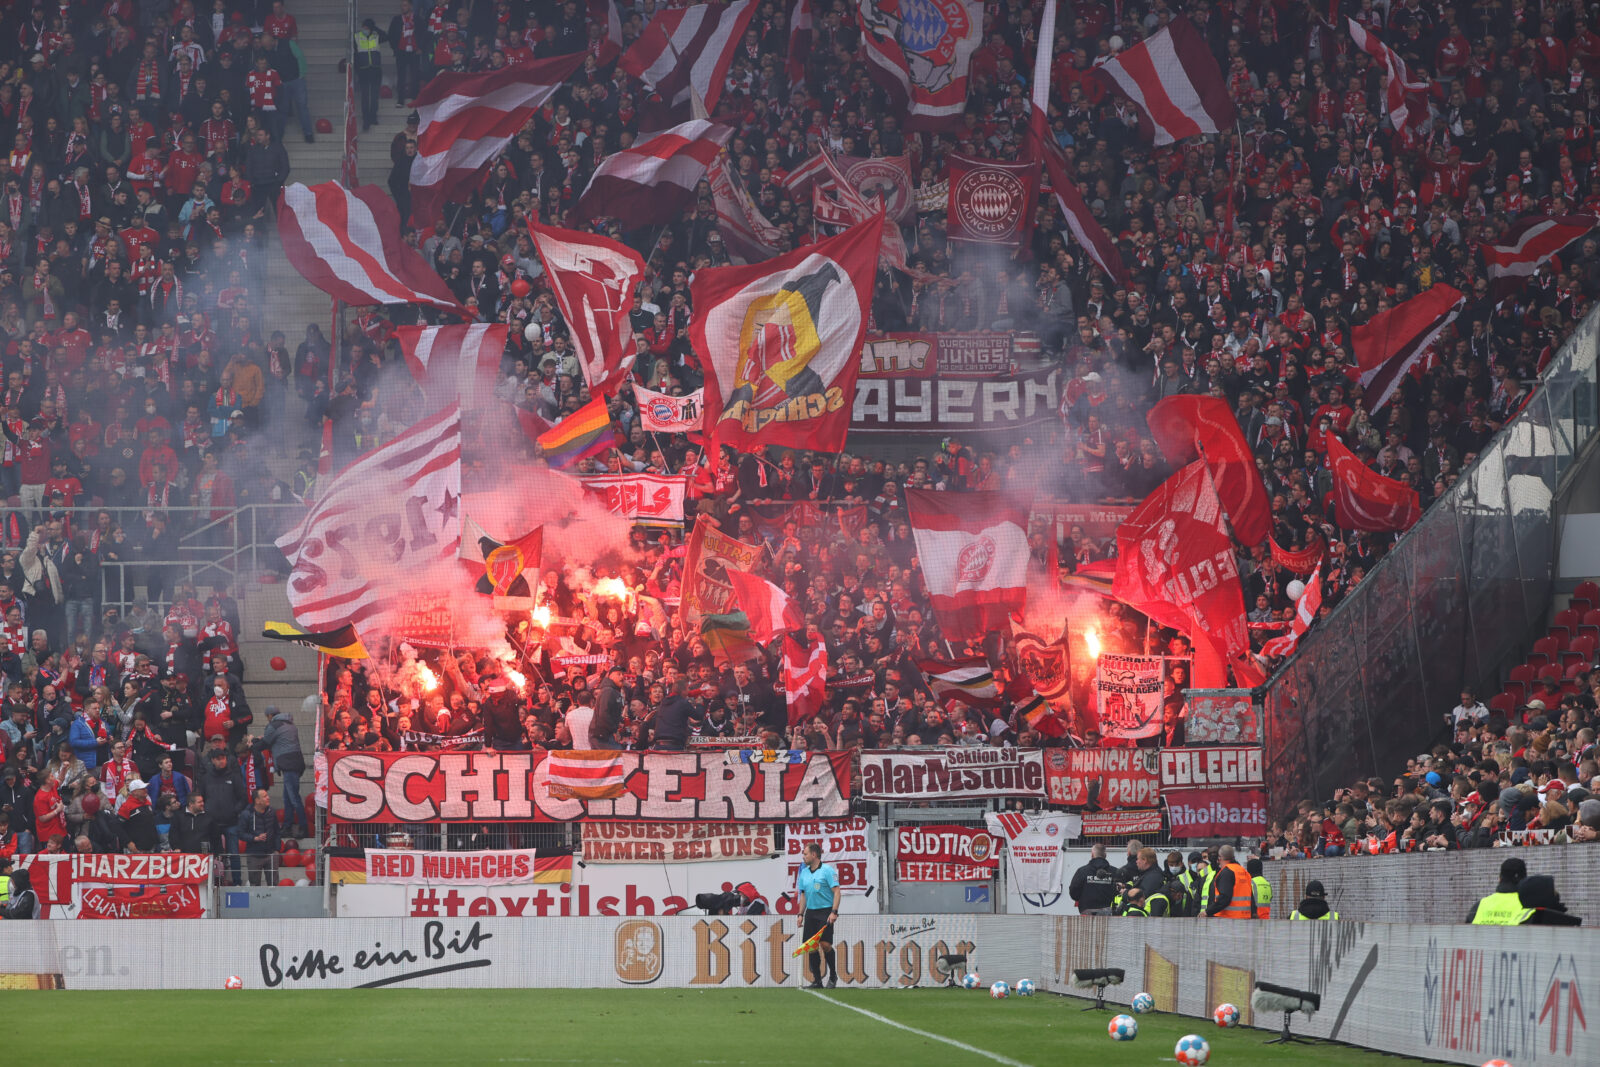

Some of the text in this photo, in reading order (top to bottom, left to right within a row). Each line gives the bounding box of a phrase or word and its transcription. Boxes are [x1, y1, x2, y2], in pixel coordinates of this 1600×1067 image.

[980, 173, 1020, 197] BAYERN
[961, 202, 1005, 232] MÜNCHEN
[939, 338, 1010, 349] DURCHHALTEN
[859, 339, 933, 374] ATIC
[940, 348, 1010, 364] JUNGS!
[965, 363, 977, 371] CAN
[978, 363, 999, 371] STOP
[852, 368, 1058, 423] AYERN
[606, 482, 672, 516] BELS
[1090, 512, 1129, 524] Mün
[946, 749, 998, 765] Sektion
[1161, 749, 1264, 786] COLEGIO
[1050, 776, 1160, 805] RED PRIDE
[788, 817, 867, 836] WIR SIND
[1084, 823, 1160, 834] IMMER ANWESEND
[584, 837, 769, 860] IMMER BEI UNS
[829, 836, 866, 853] DIR
[899, 828, 1000, 862] SÜDTIROL
[79, 853, 210, 880] HARZBURG
[371, 854, 415, 877] RED
[788, 863, 868, 889] TBI
[898, 862, 953, 881] LETZTE
[922, 917, 936, 929] Bit
[259, 920, 493, 987] Bitte ein Bit
